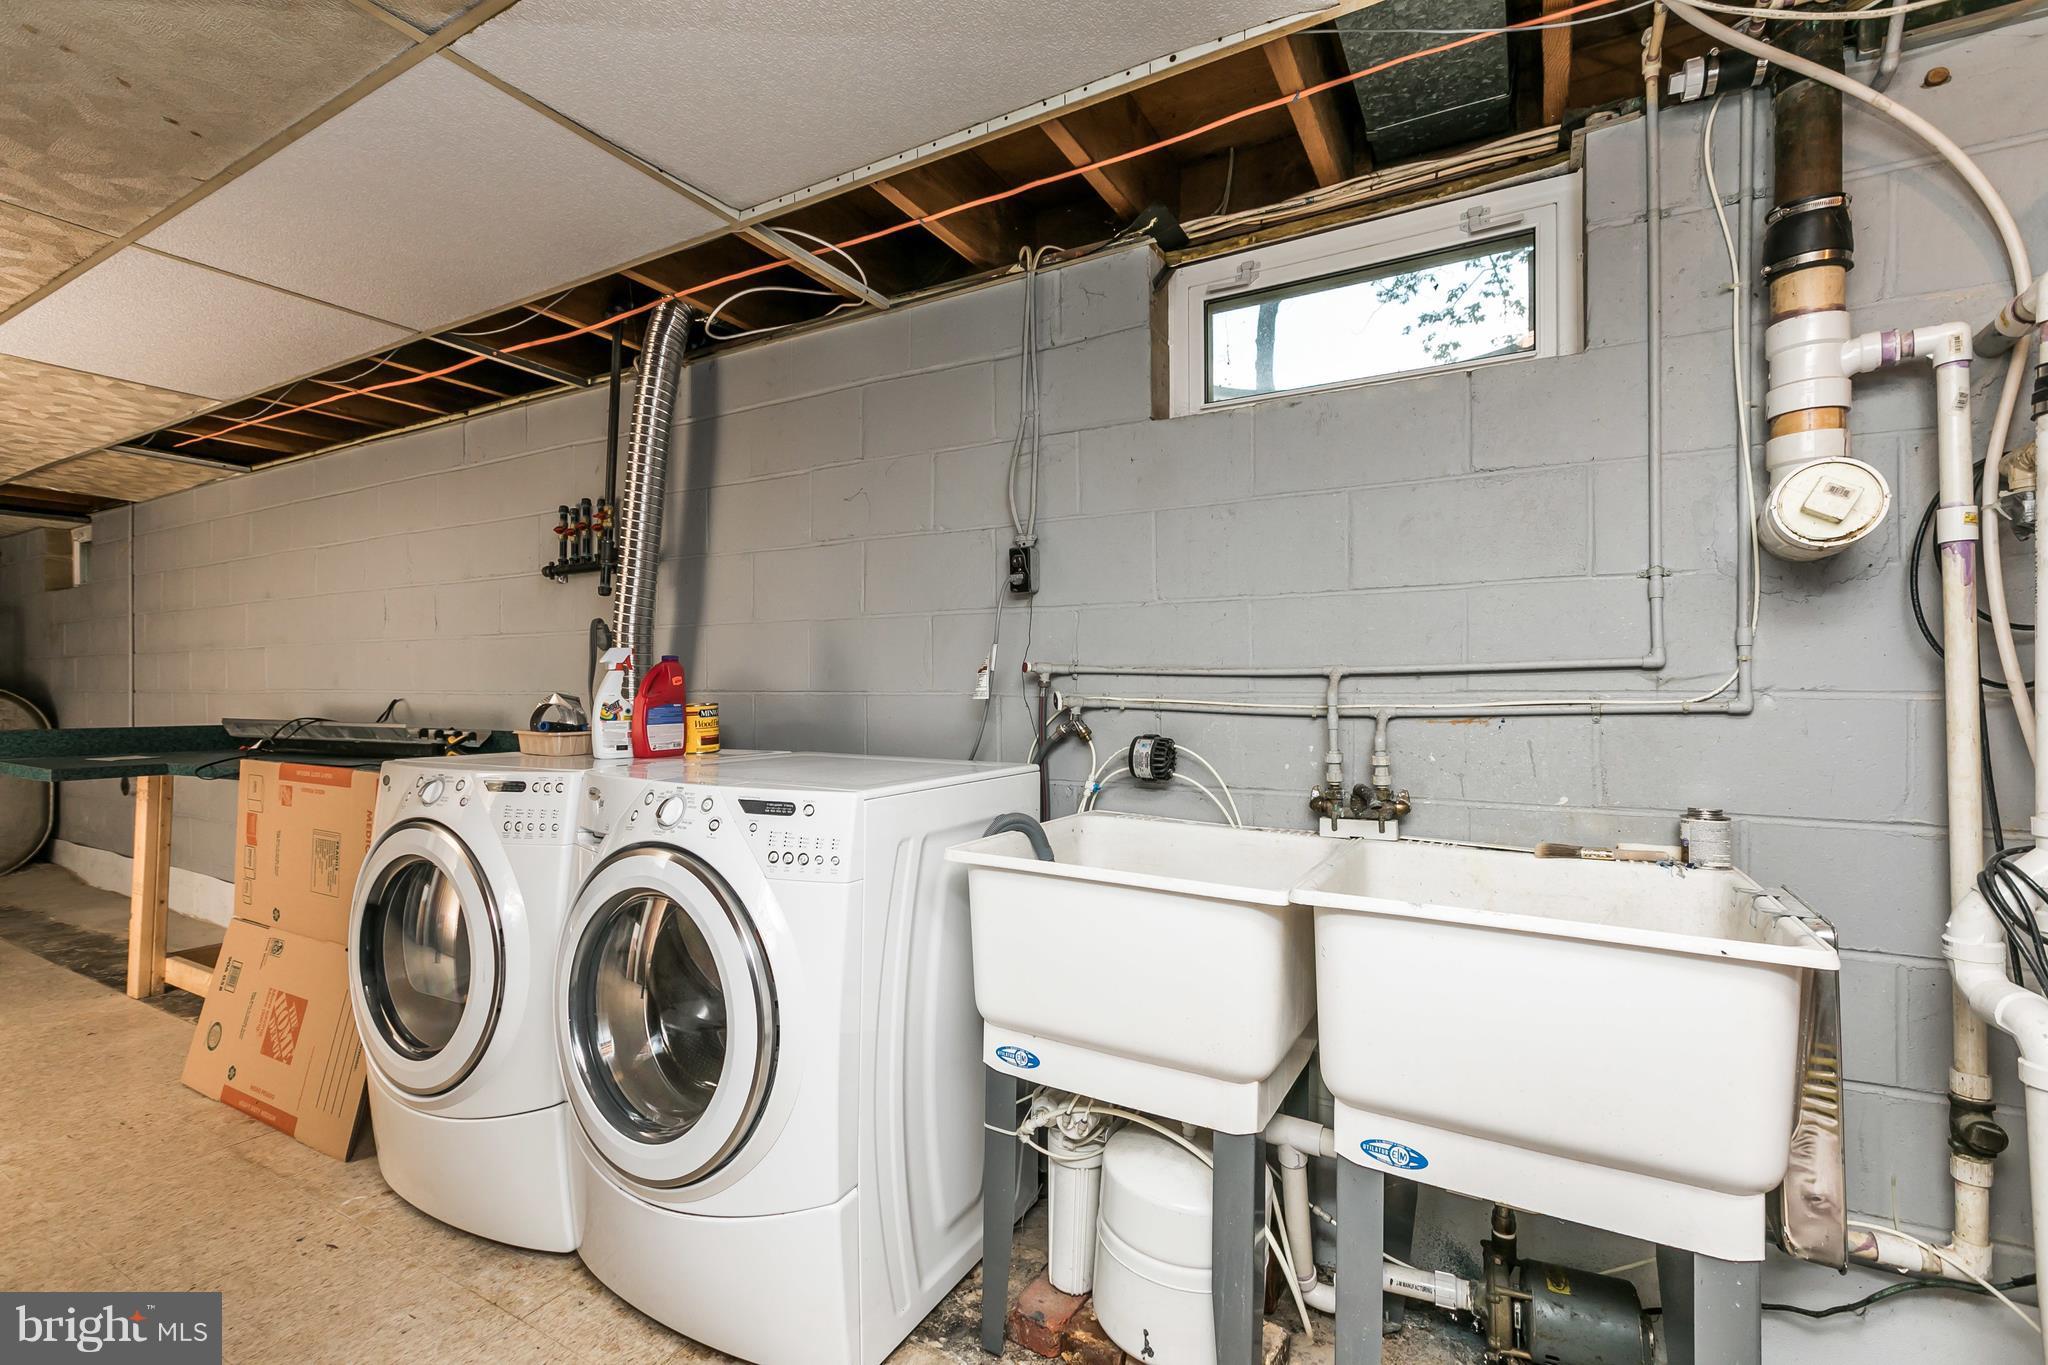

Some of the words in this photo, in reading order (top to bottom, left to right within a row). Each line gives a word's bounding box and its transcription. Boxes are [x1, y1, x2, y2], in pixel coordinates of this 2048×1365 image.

[274, 993, 294, 1061] HOME
[289, 1001, 299, 1030] THE
[269, 1016, 281, 1059] DEPOT
